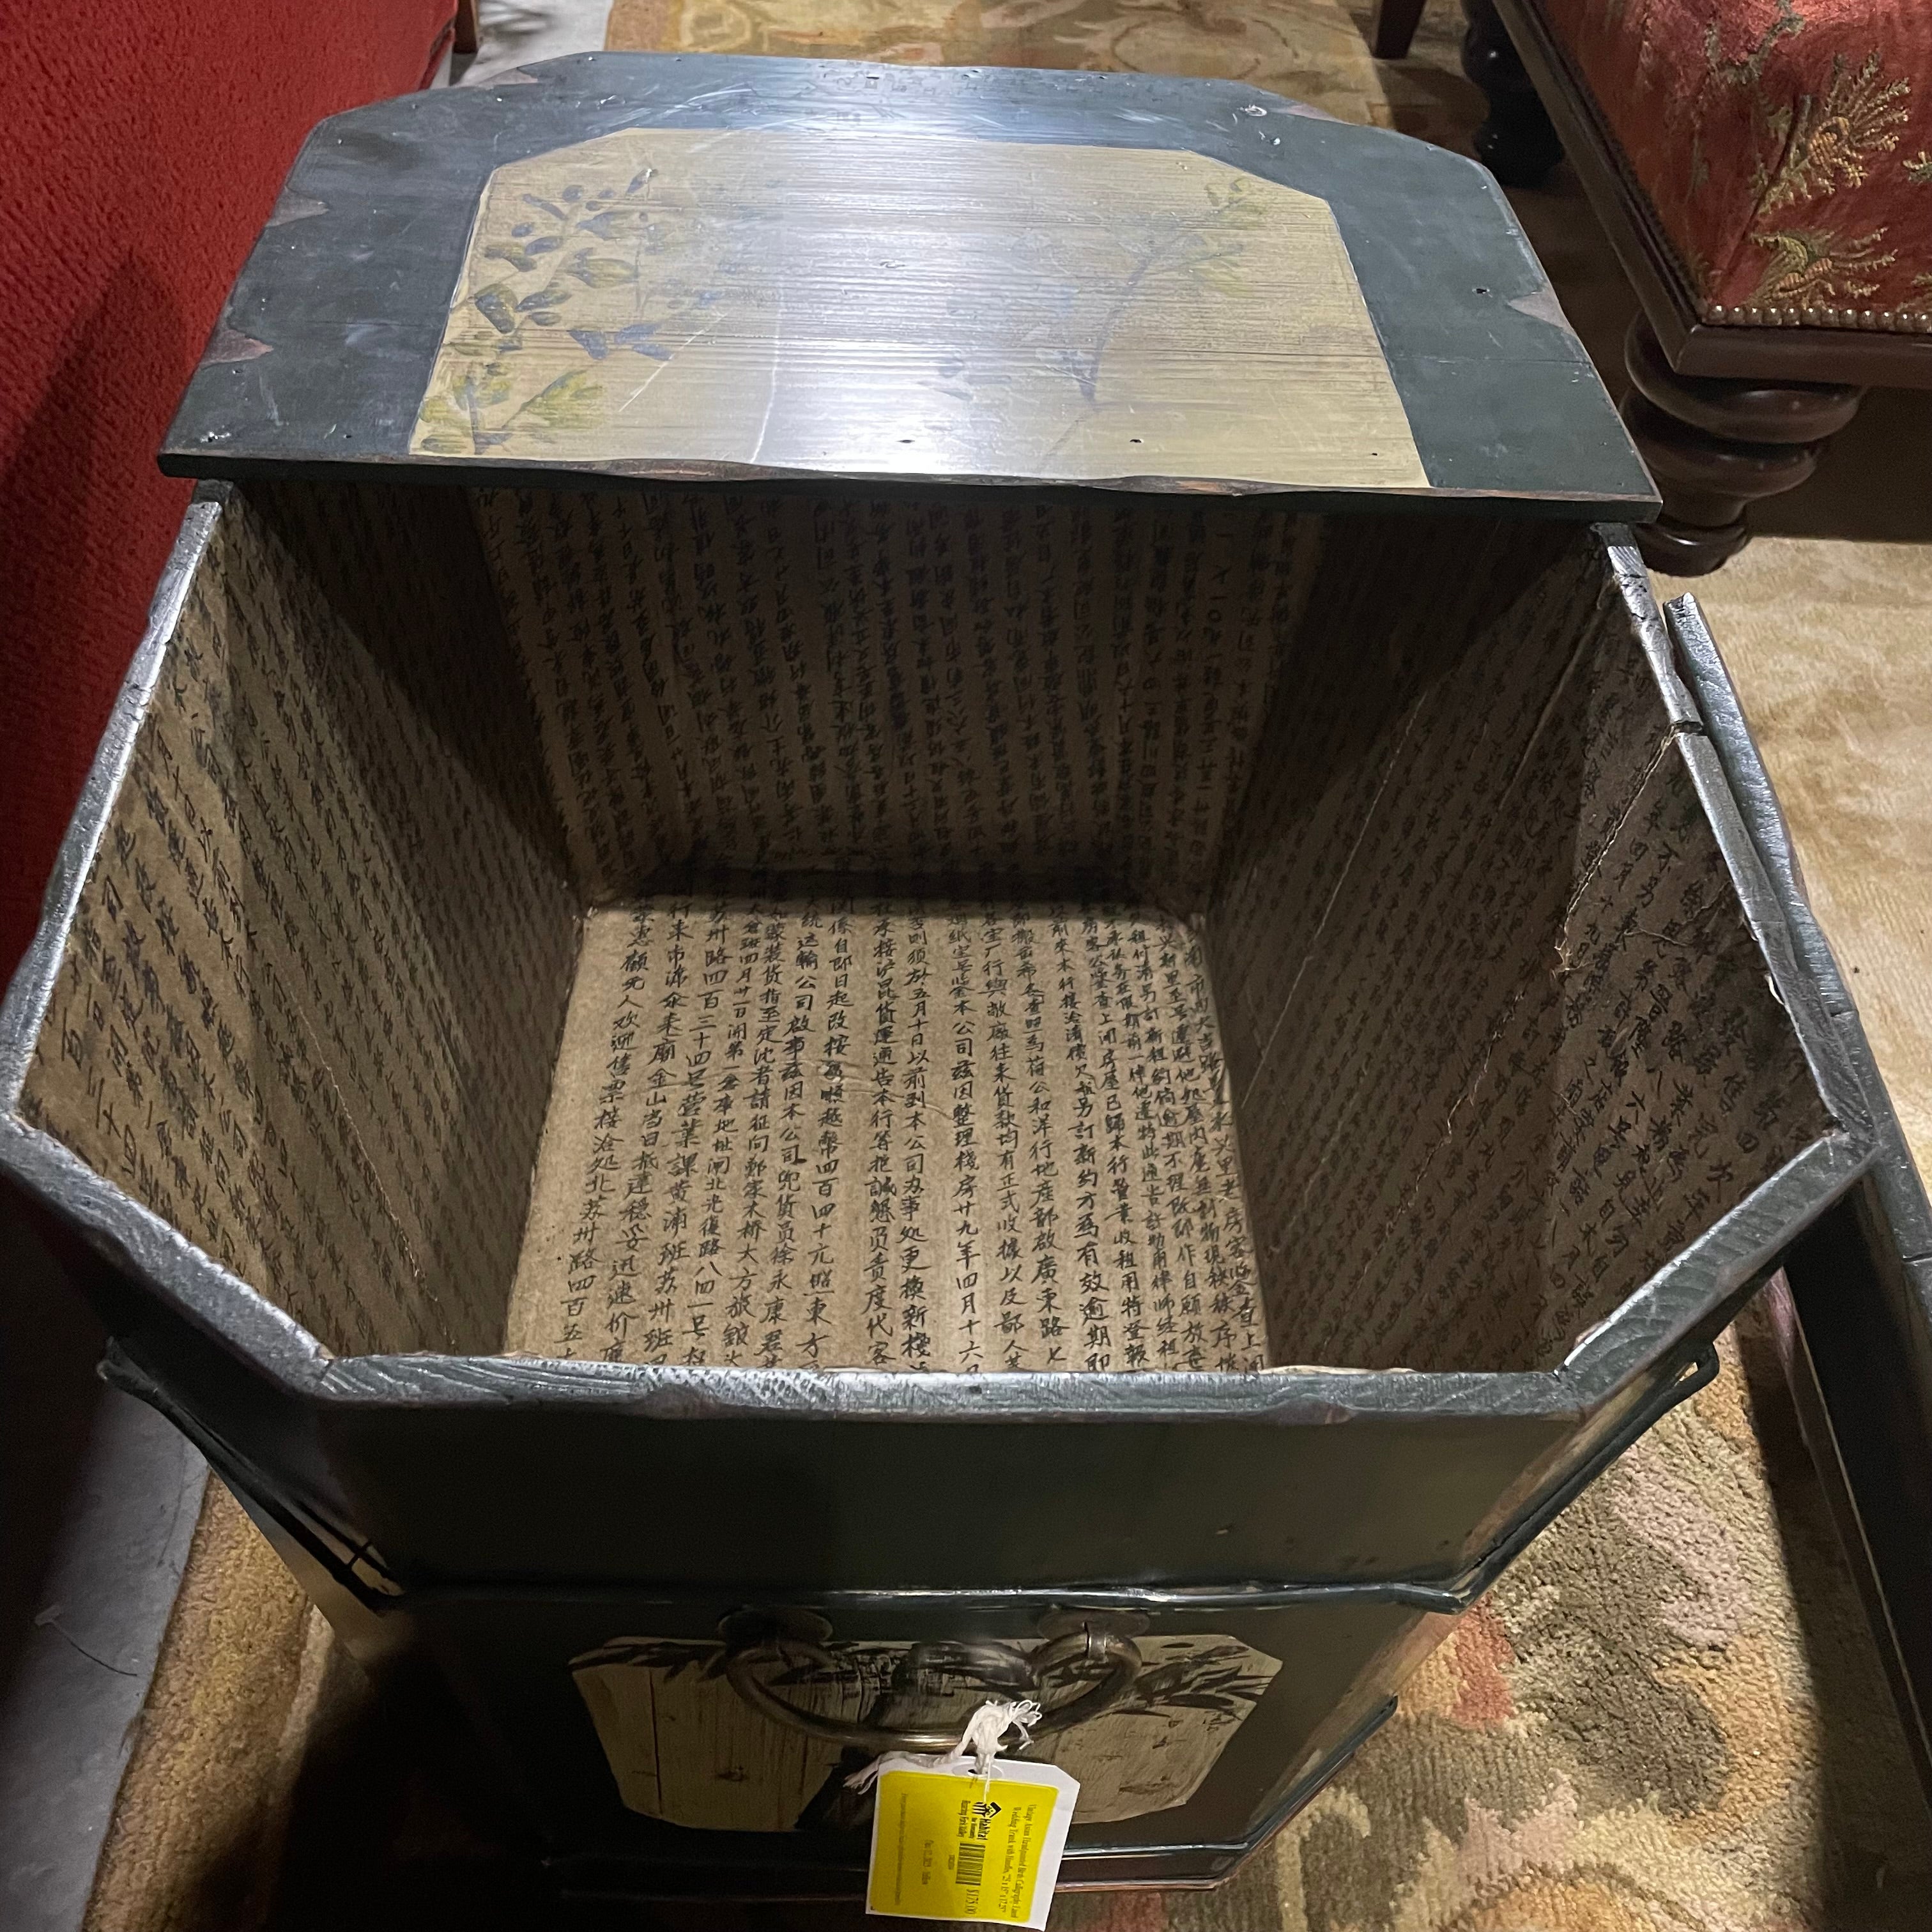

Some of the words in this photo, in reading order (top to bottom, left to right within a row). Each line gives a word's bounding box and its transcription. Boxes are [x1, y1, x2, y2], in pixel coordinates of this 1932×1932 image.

[959, 1816, 969, 1825] Fork
[977, 1818, 992, 1840] Habitat
[956, 1825, 968, 1837] Valley
[965, 1889, 979, 1914] $175.00
